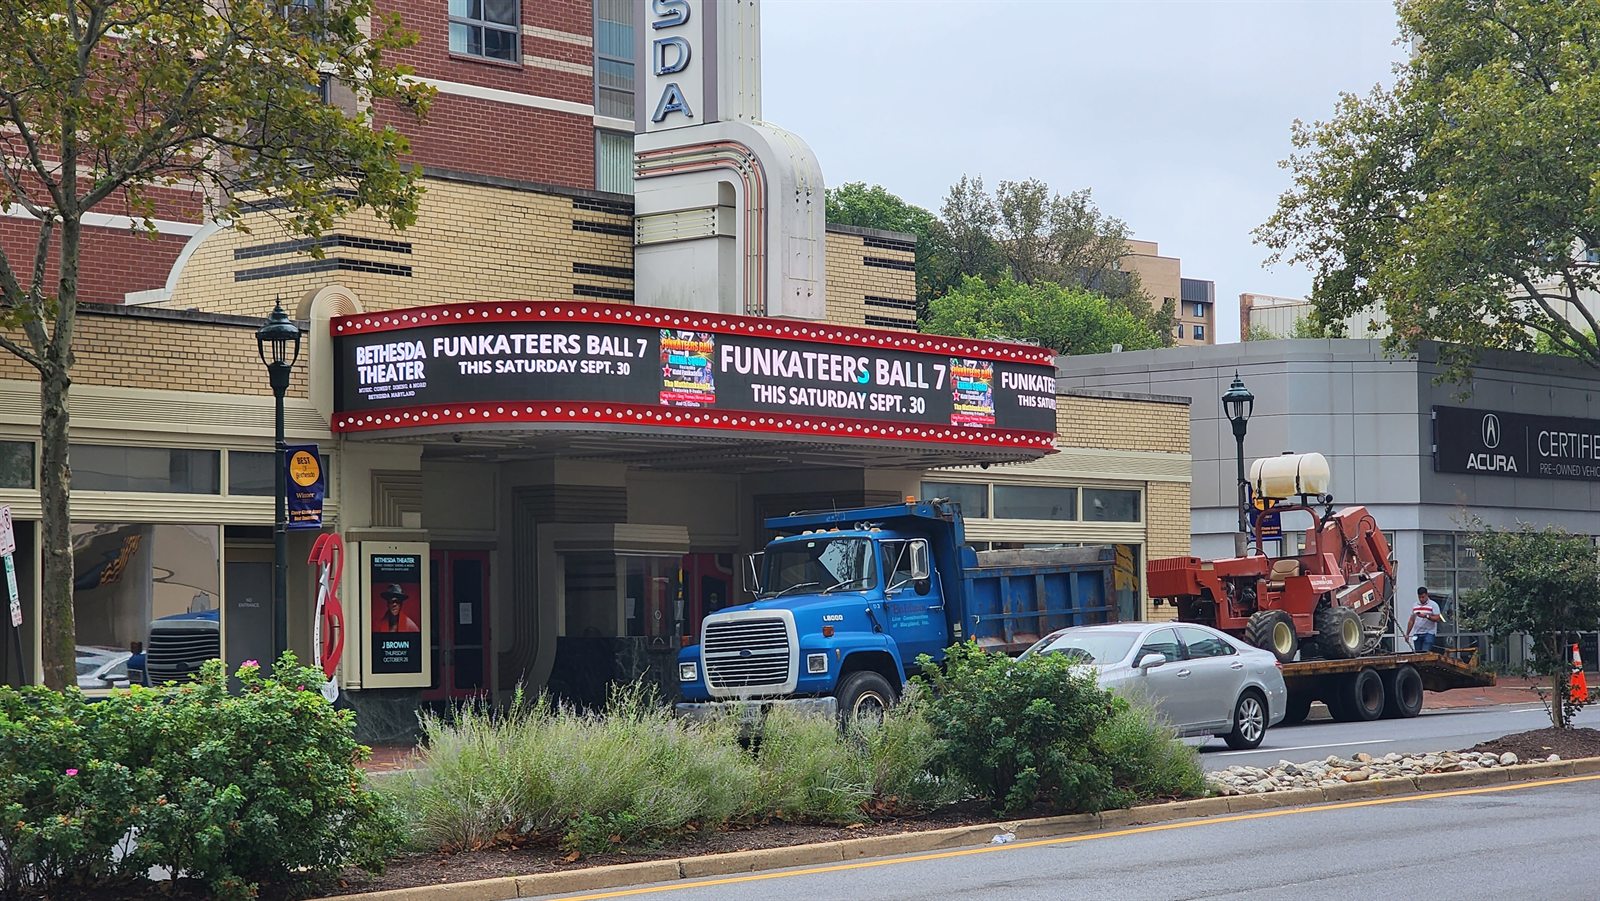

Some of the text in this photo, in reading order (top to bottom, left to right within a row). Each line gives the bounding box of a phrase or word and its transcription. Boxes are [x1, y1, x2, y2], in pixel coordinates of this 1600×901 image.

[356, 340, 427, 365] BETHESDA
[433, 334, 648, 358] FUNKATEERS BALL 7
[358, 361, 425, 385] THEATER
[458, 359, 630, 375] THIS SATURDAY SEPT. 30
[721, 344, 946, 390] FUNKATEERS BALL 7
[751, 384, 925, 414] THIS SATURDAY SEPT. 30
[1017, 394, 1037, 408] THIS
[296, 456, 311, 465] BEST
[1466, 453, 1518, 472] ACURA
[1540, 462, 1581, 476] PRE-OWNED
[386, 641, 410, 649] BROWN
